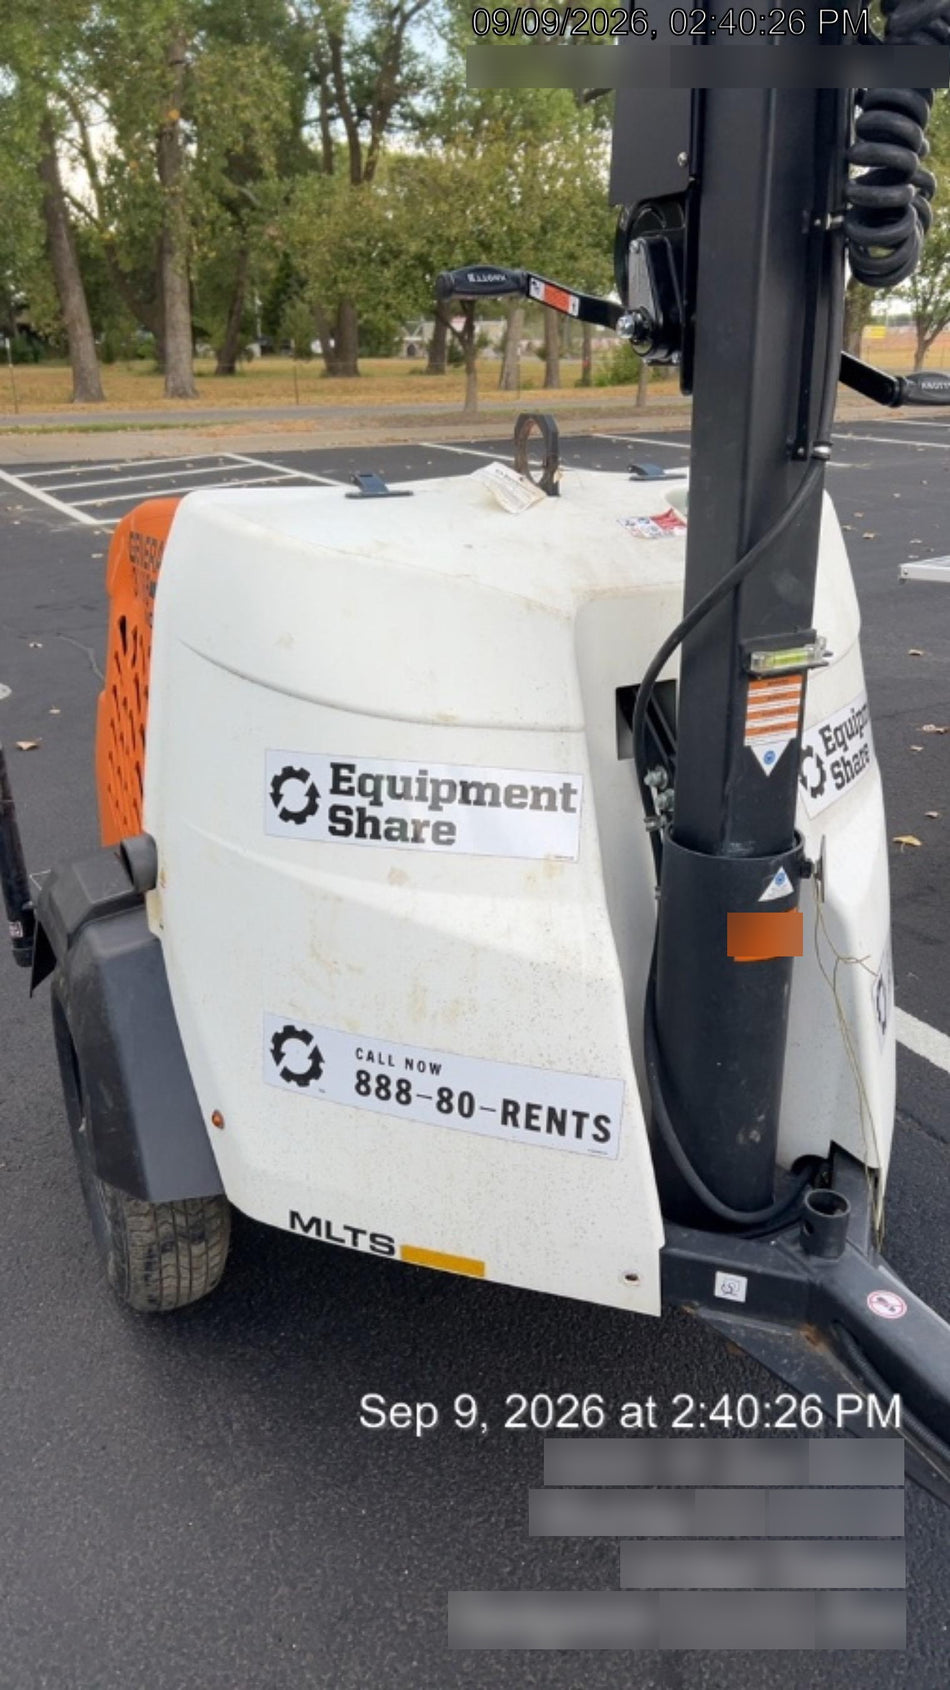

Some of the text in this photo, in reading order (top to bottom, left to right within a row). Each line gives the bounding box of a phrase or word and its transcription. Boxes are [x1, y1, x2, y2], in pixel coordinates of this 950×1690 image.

[329, 762, 578, 813] Equipment
[830, 743, 870, 791] Share
[328, 804, 457, 846] Share
[355, 1047, 442, 1076] CALL NOW
[354, 1069, 612, 1143] 888-80-RENTS
[289, 1209, 395, 1256] MLTS
